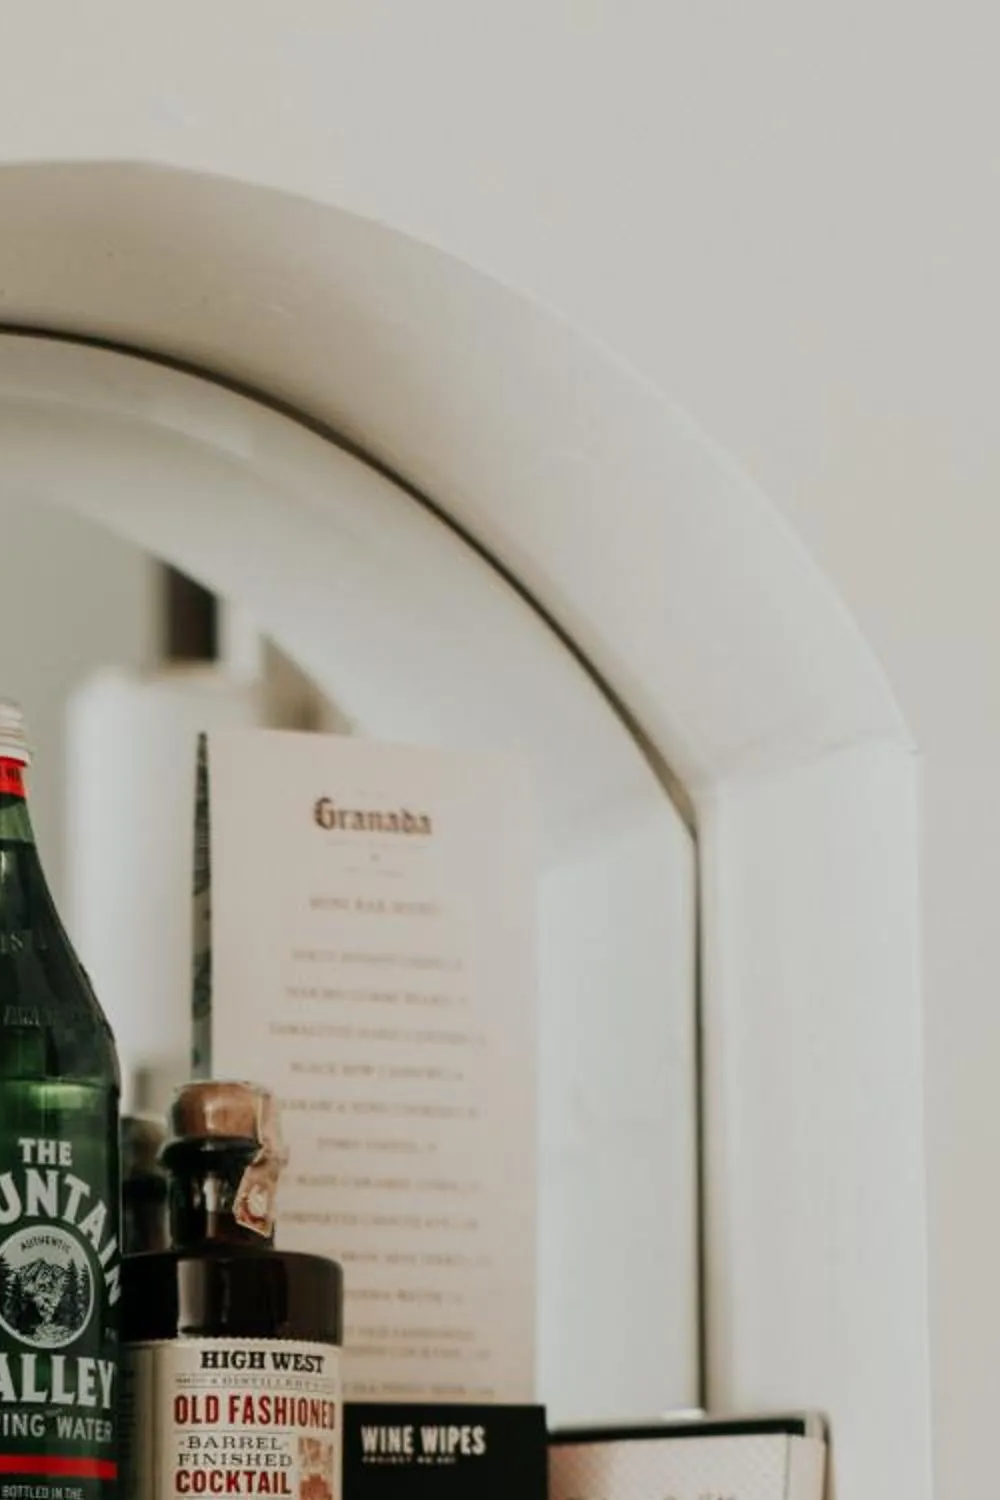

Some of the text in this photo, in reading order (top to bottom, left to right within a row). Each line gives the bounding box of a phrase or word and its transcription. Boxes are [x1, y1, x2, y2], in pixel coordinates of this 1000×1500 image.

[314, 797, 432, 835] Granada
[18, 1137, 72, 1167] THE
[20, 1234, 72, 1253] AUTHENTIC
[201, 1351, 265, 1370] HIGH
[272, 1352, 324, 1373] WEST
[173, 1395, 336, 1430] OLD FASHIONED
[56, 1413, 112, 1442] WATER
[361, 1424, 487, 1456] WINE WIPES
[178, 1452, 293, 1468] FINISHED
[1, 1484, 83, 1500] BOTTLED IN THE
[175, 1469, 292, 1495] COCKTAIL
